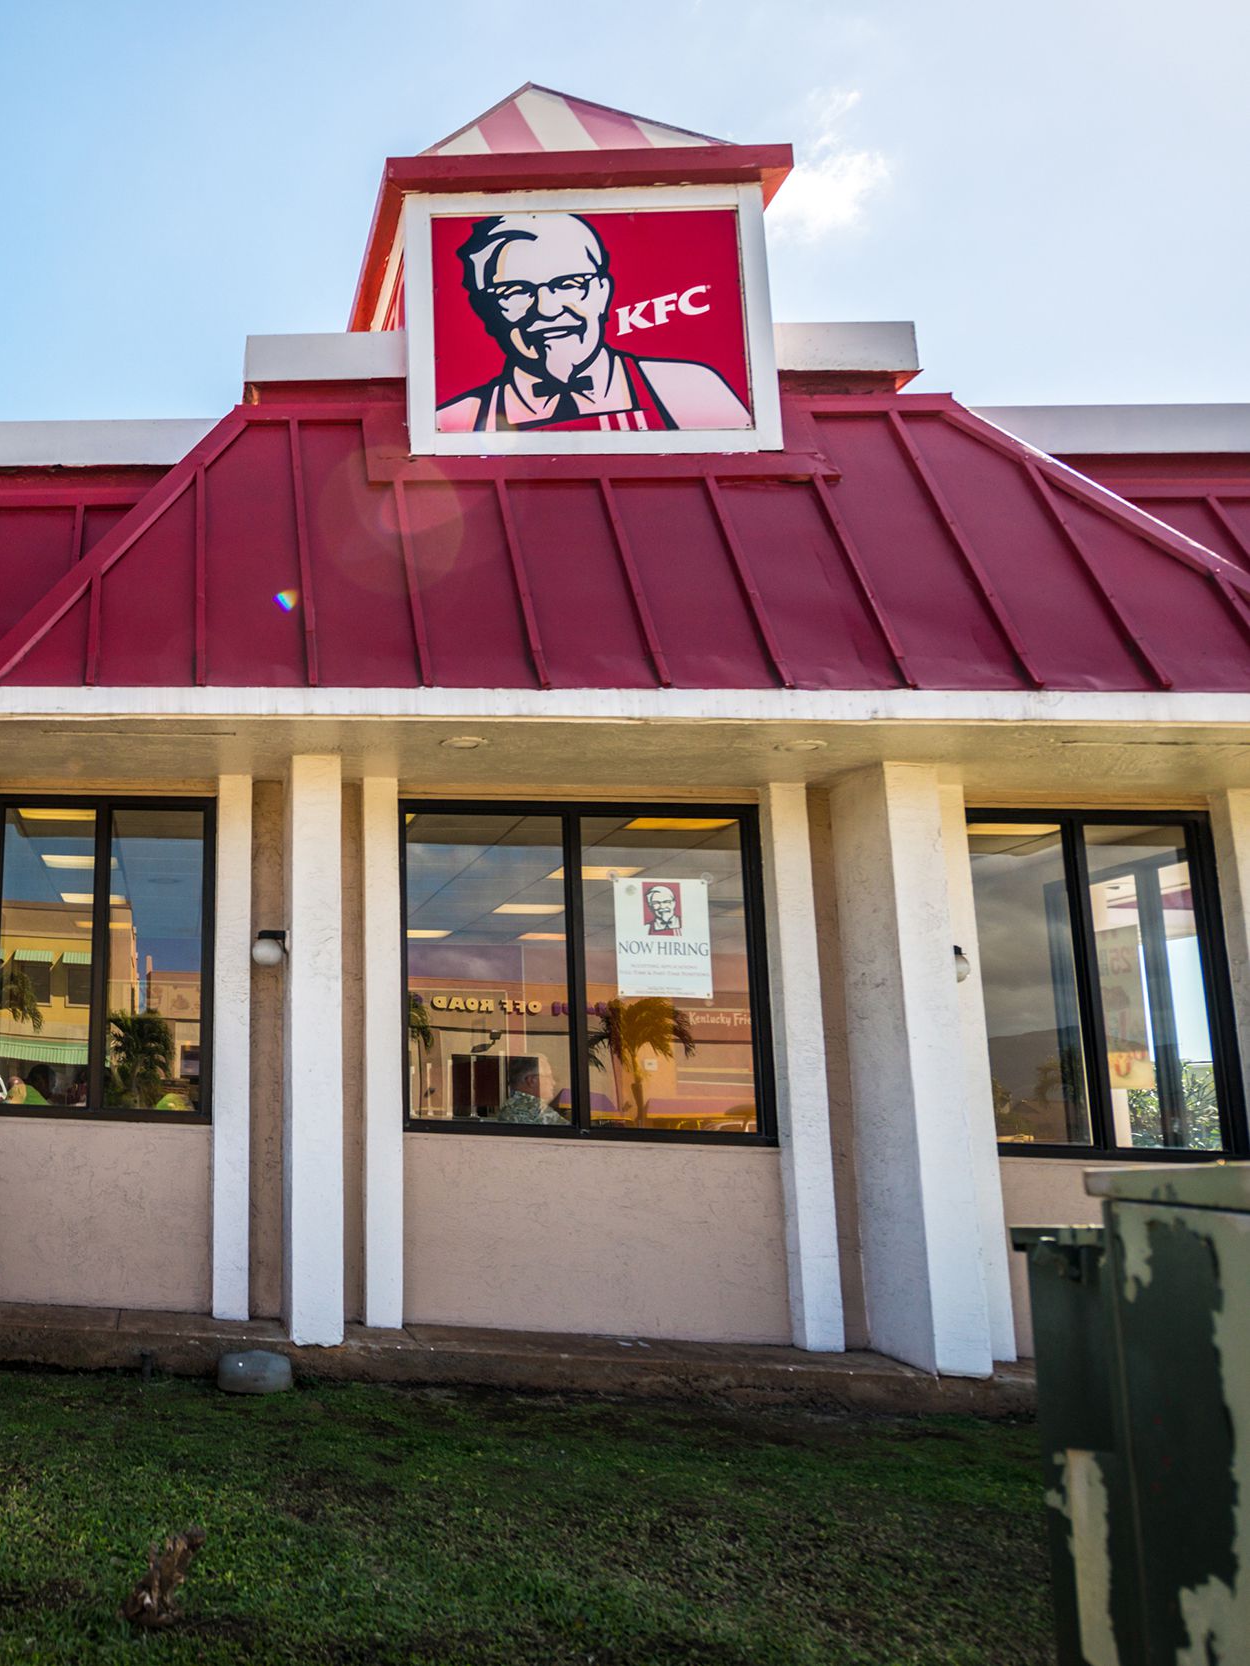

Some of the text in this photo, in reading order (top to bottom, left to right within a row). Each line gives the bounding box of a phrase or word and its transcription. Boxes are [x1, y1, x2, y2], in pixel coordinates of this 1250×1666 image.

[615, 284, 710, 336] KFC
[618, 940, 709, 956] NOW HIRING
[688, 1011, 751, 1027] Kentucky Frie
